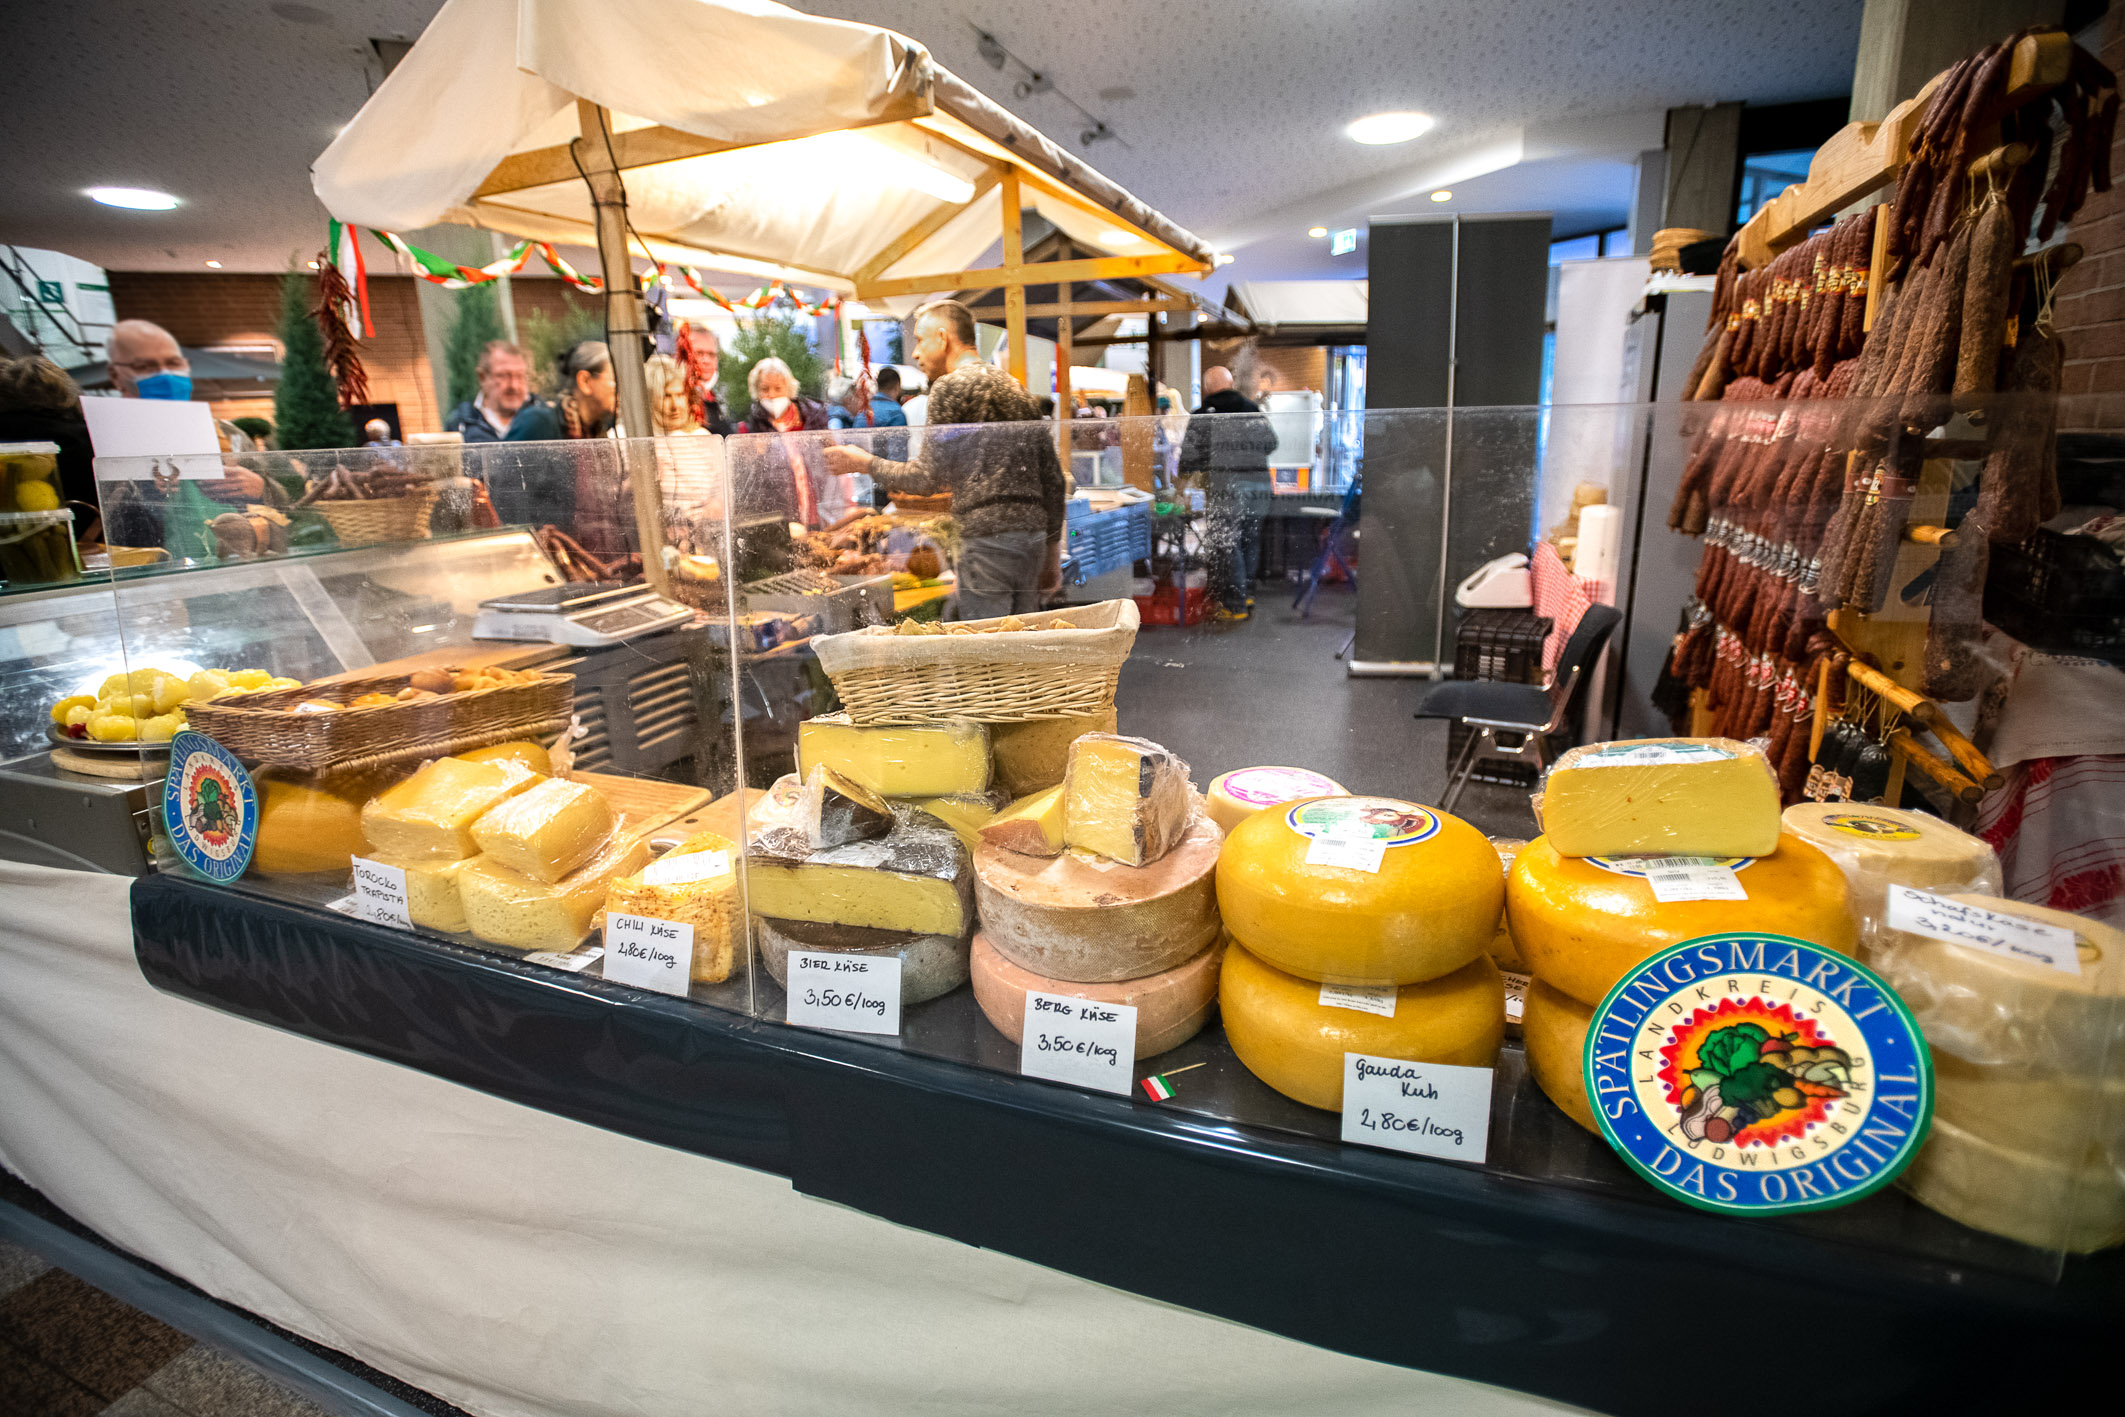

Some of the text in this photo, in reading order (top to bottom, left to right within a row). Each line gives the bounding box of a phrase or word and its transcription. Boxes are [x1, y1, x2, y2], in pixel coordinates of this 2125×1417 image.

[168, 733, 255, 807] SPÄTLINGSMARKT
[171, 823, 253, 879] DAS ORIGINAL
[616, 918, 644, 933] CHILI
[1034, 997, 1073, 1016] BERG
[1594, 941, 1894, 1120] SPÄTLINGSMARKT
[1638, 979, 1827, 1084] LANDKREIS
[1401, 1081, 1439, 1100] Kuh
[1648, 1063, 1920, 1203] DAS ORIGINAL
